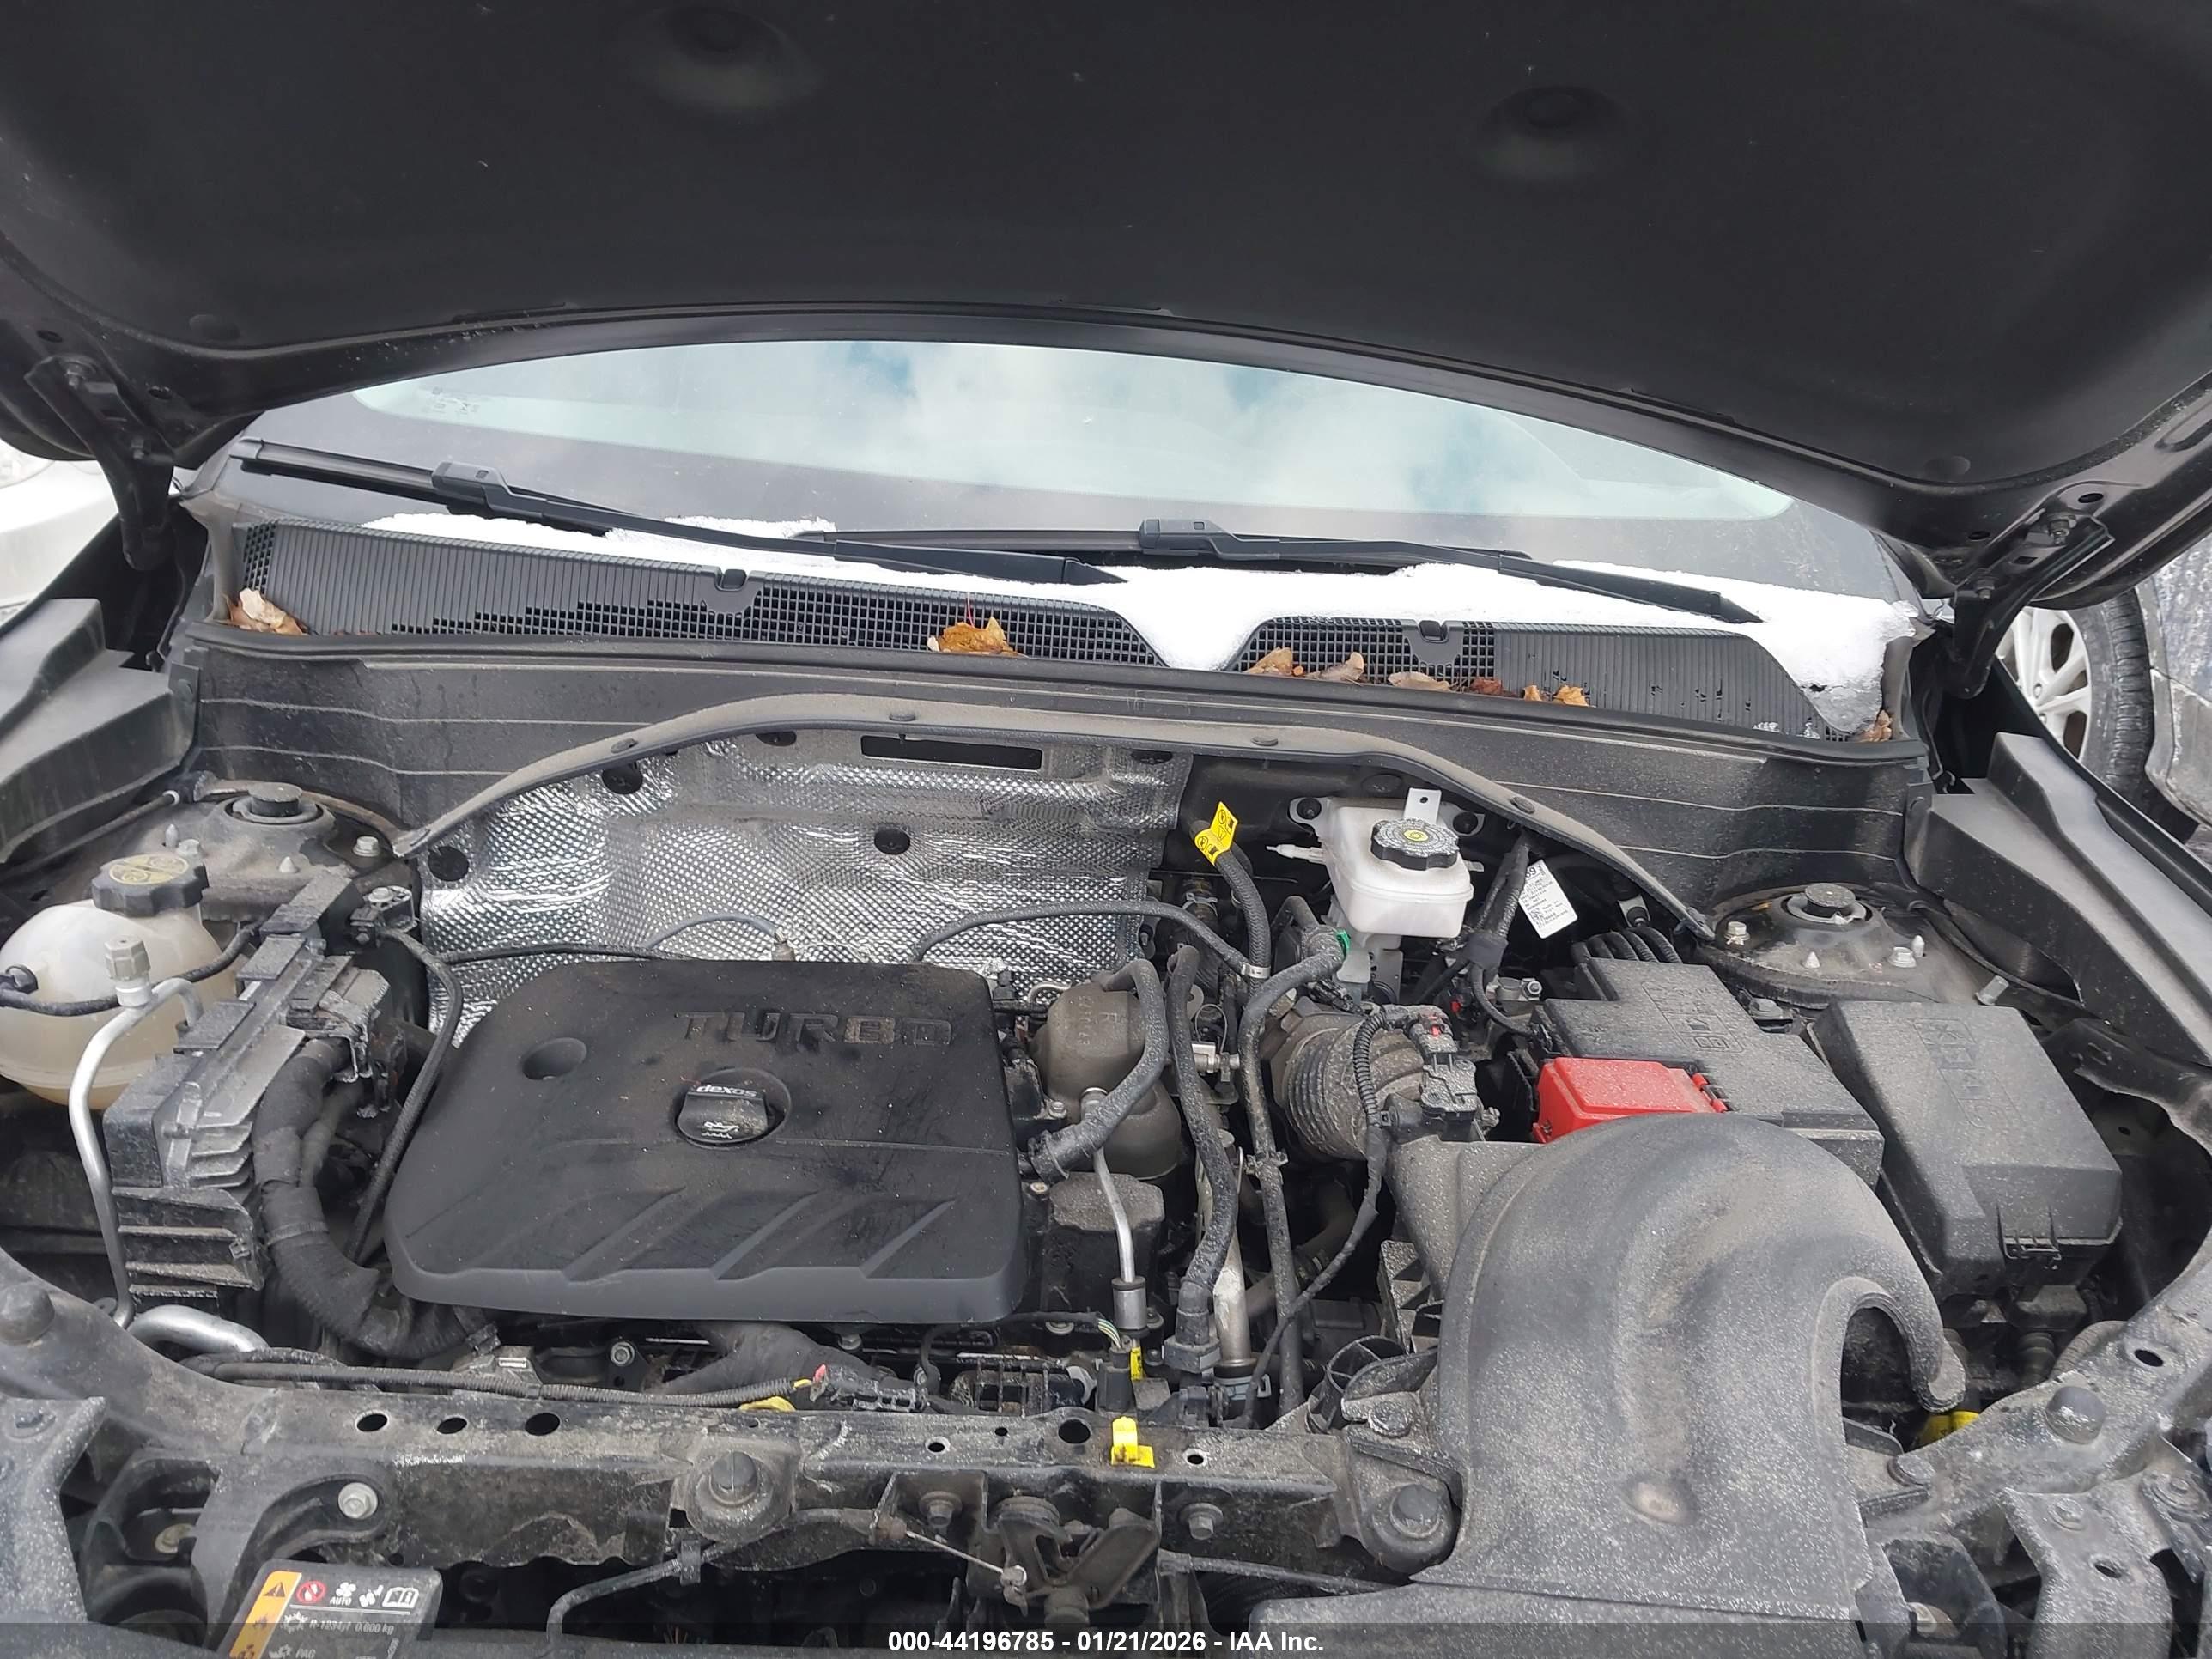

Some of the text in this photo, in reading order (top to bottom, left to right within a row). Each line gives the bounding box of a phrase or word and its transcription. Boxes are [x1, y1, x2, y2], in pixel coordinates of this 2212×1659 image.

[681, 1011, 952, 1047] TURBO
[696, 1084, 757, 1098] dexos
[329, 1595, 352, 1606] AUTO
[381, 1623, 395, 1636] kg
